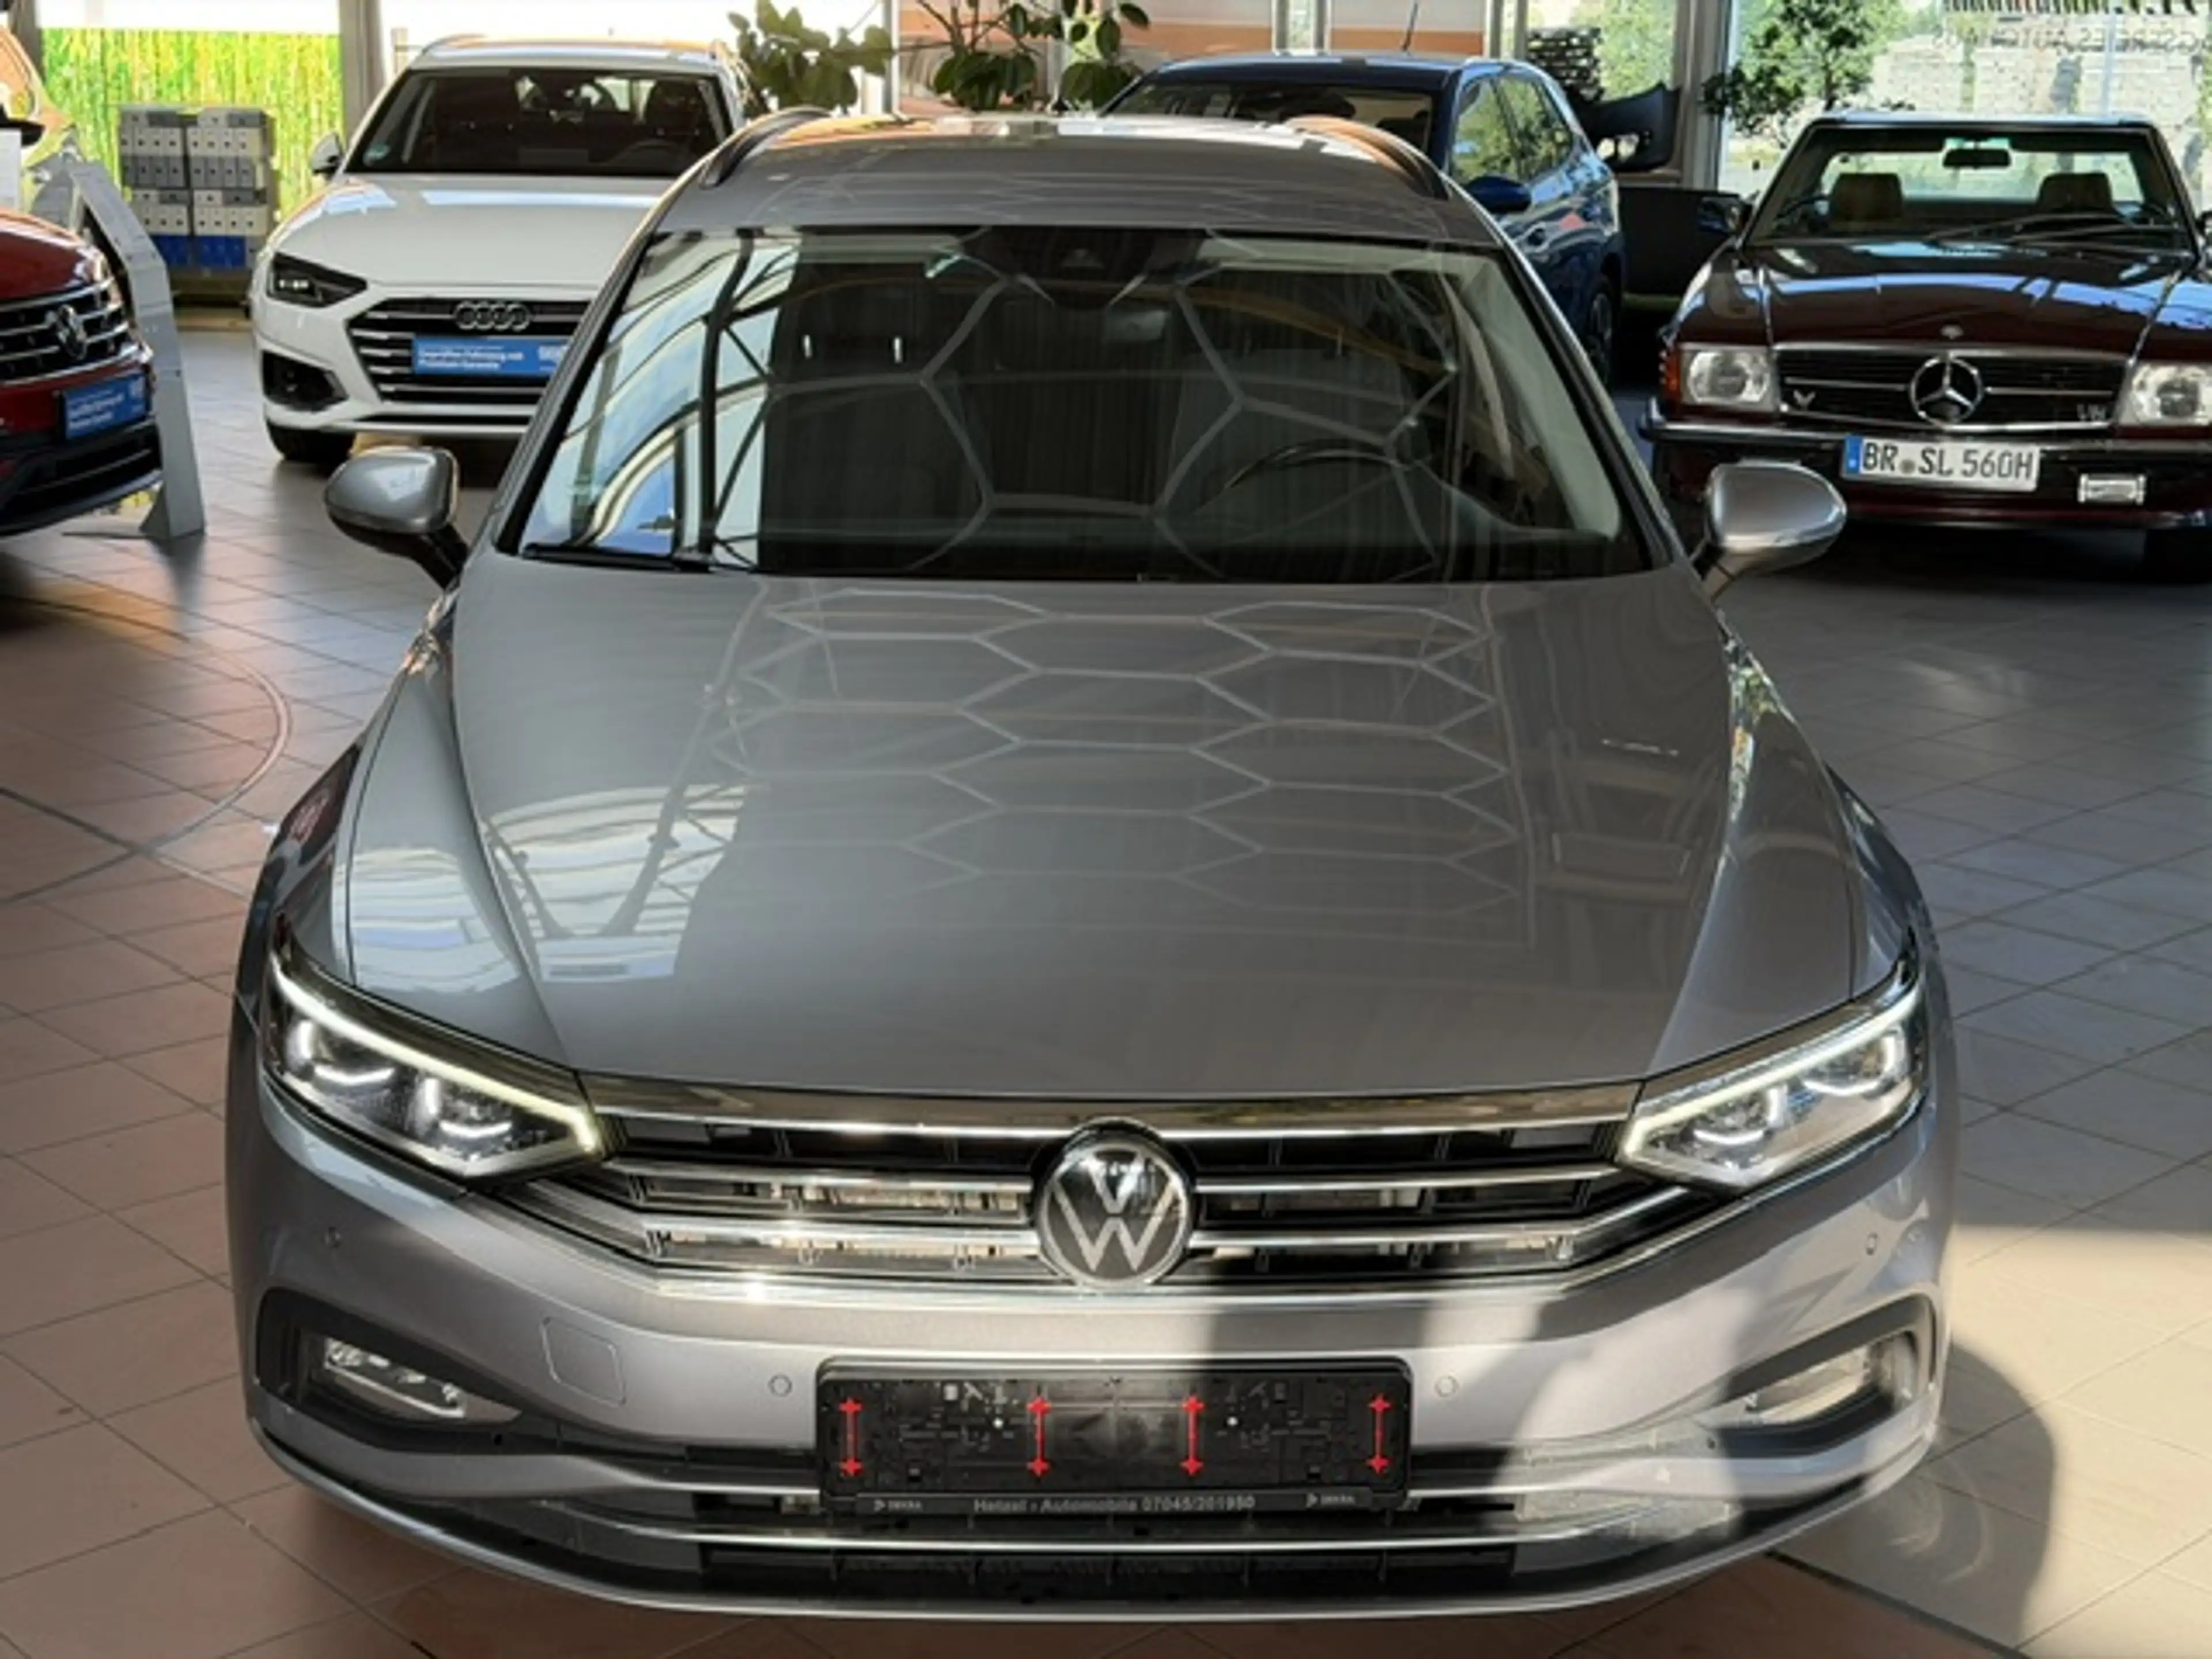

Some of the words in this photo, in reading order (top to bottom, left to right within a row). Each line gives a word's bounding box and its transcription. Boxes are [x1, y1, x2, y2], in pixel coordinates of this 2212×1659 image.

[1863, 442, 1899, 471] BR
[1918, 446, 1953, 476] SL
[1961, 449, 2033, 479] 560H
